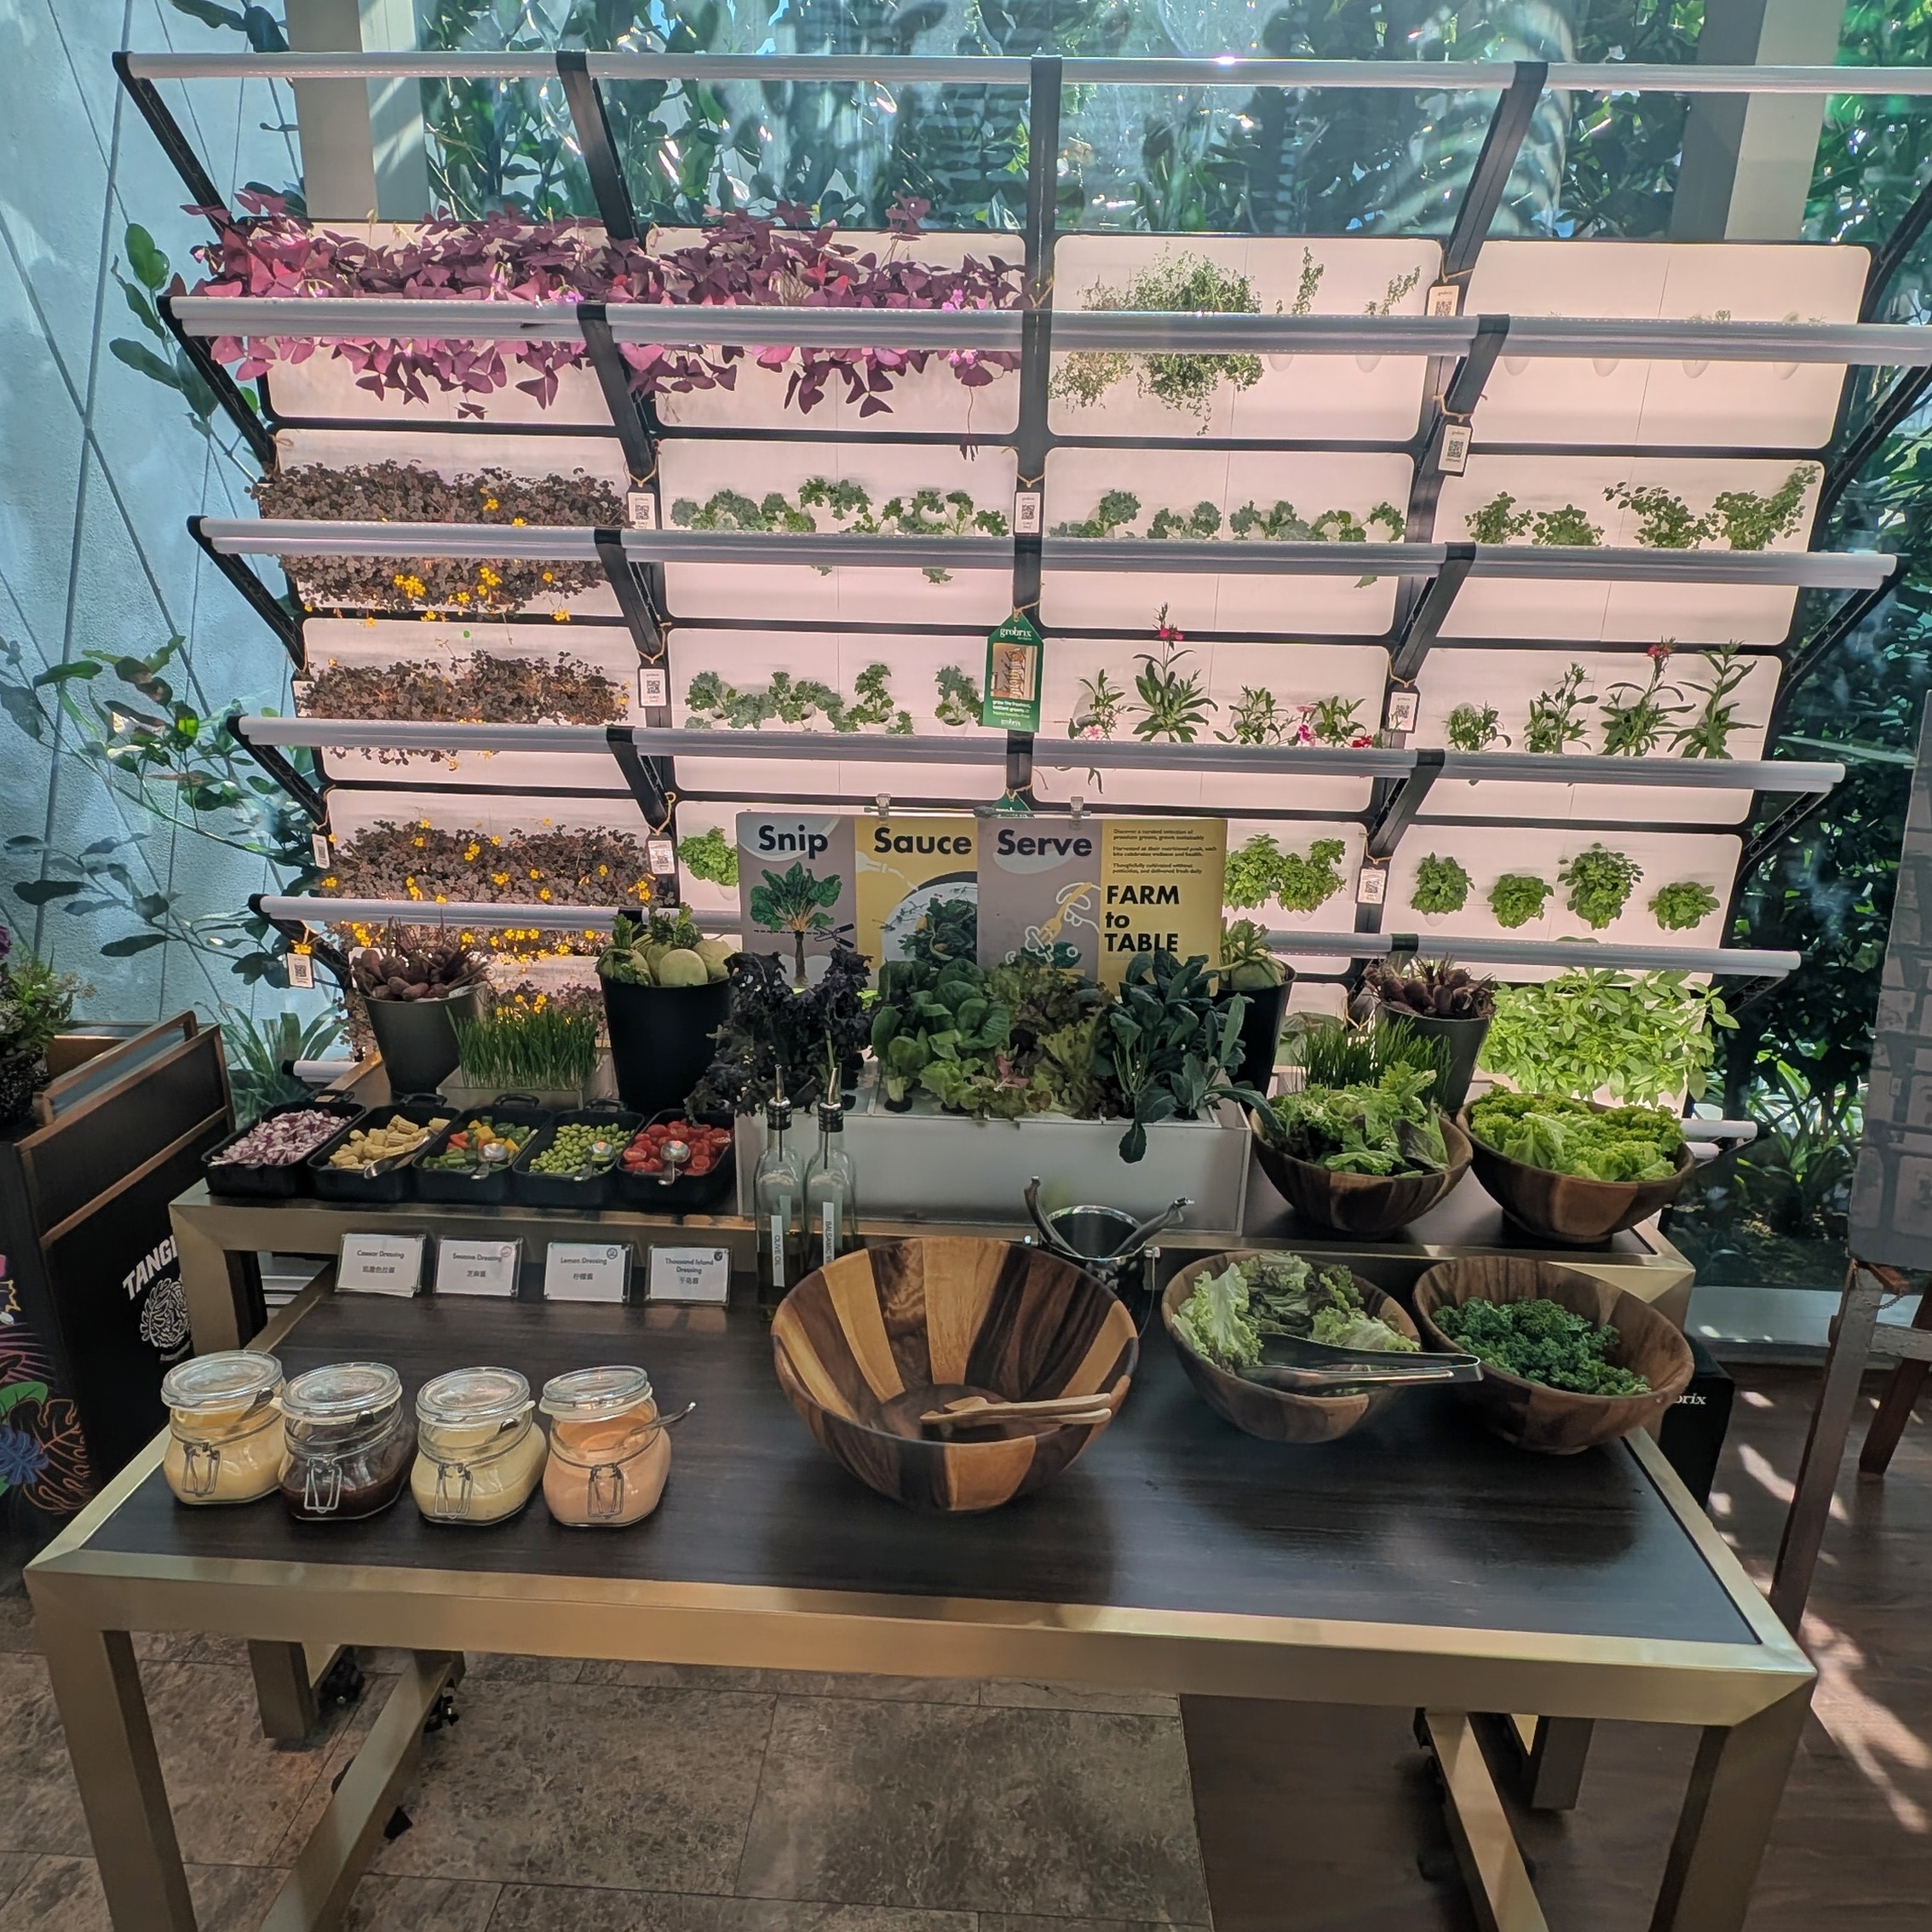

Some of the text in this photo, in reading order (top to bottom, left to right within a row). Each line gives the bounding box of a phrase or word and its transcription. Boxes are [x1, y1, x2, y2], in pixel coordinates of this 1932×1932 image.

[999, 626, 1032, 638] grobrix
[758, 824, 829, 860] Snip
[874, 826, 972, 855] Sauce
[997, 829, 1093, 857] Serve
[1107, 885, 1179, 905] FARM
[1105, 911, 1130, 929] to
[1104, 933, 1179, 952] TABLE
[379, 1251, 405, 1260] Dressing
[477, 1254, 503, 1262] Dressing
[582, 1257, 607, 1266] Dressing
[676, 1266, 702, 1275] Dressing
